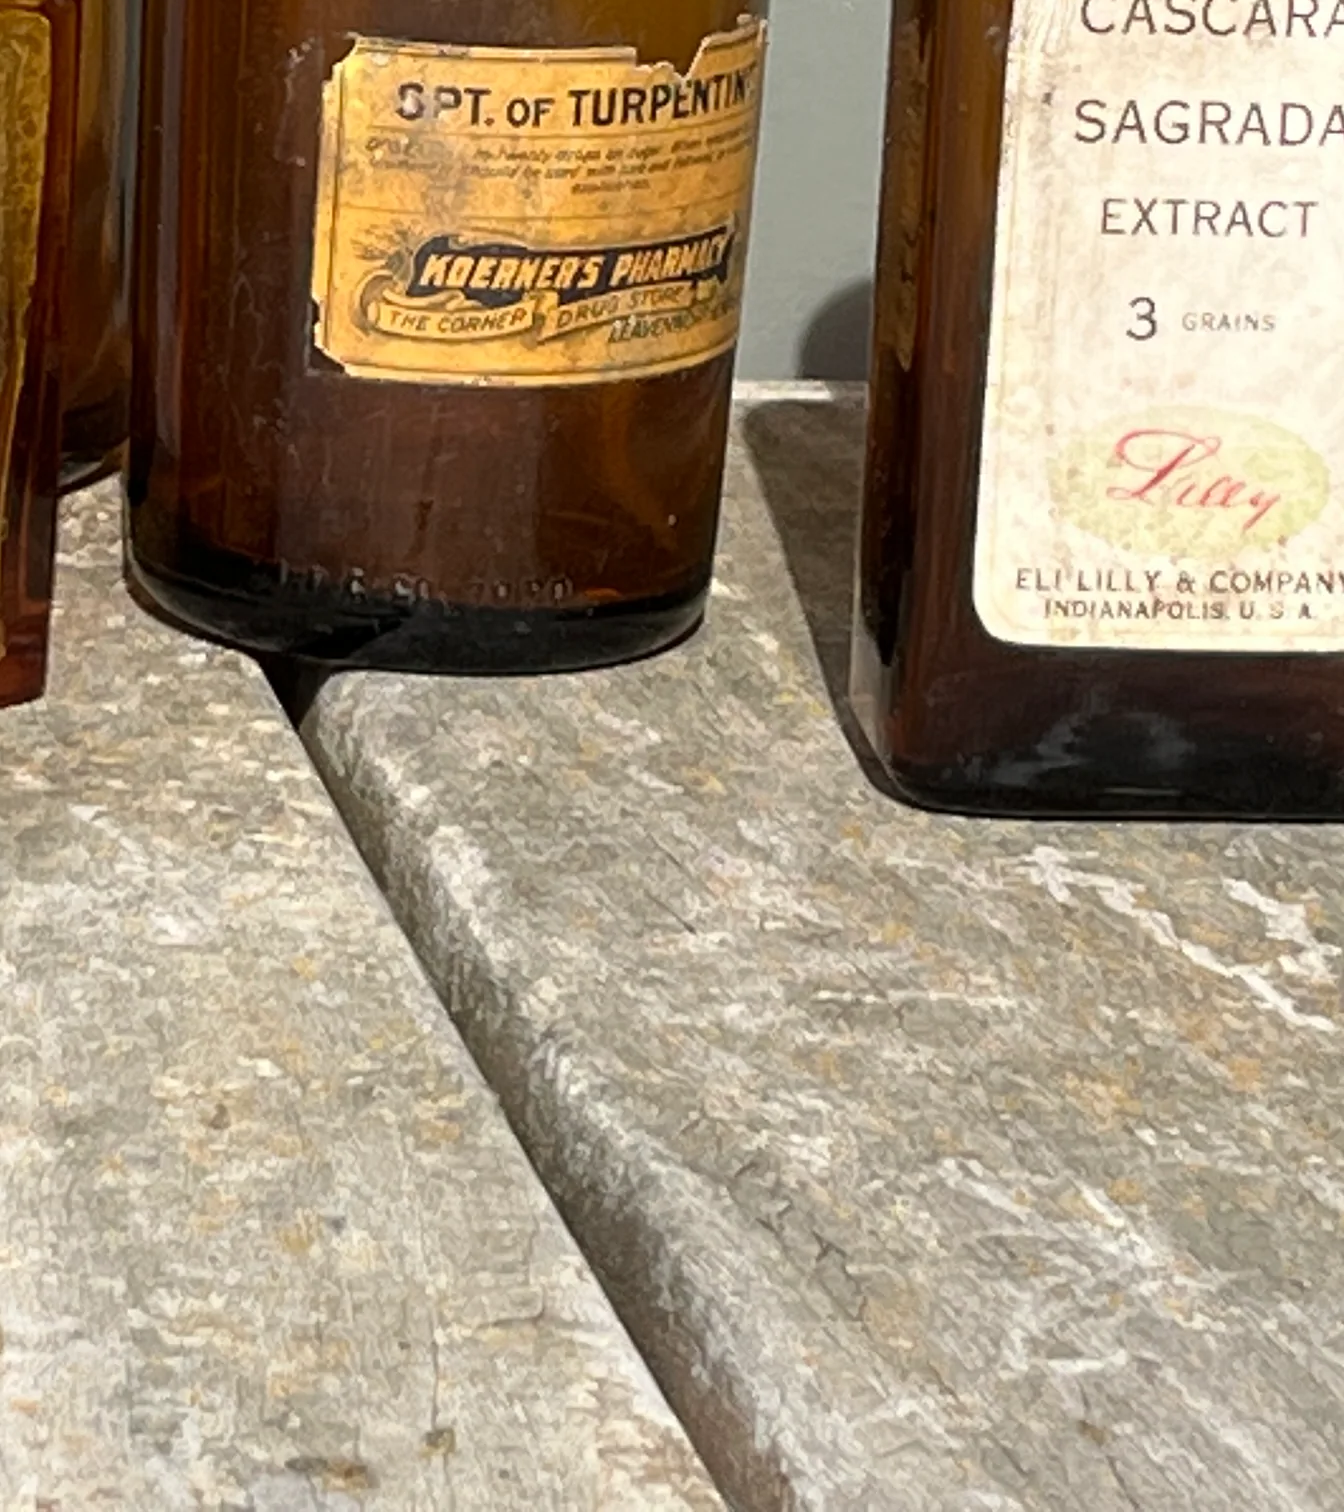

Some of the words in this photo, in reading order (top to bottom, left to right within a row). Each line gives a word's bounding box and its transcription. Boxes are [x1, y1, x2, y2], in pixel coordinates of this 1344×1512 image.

[507, 97, 555, 128] OF
[568, 70, 752, 127] TURPENTIN
[1100, 197, 1319, 238] EXTRACT
[390, 310, 428, 333] THE
[439, 310, 526, 334] CORNER
[557, 294, 619, 327] DRUG
[1125, 296, 1158, 341] 3
[1181, 312, 1277, 333] GRAINS
[1106, 429, 1282, 536] Lilly
[1015, 567, 1062, 592] ELI
[1077, 568, 1162, 593] LILLY
[1176, 571, 1196, 595] &
